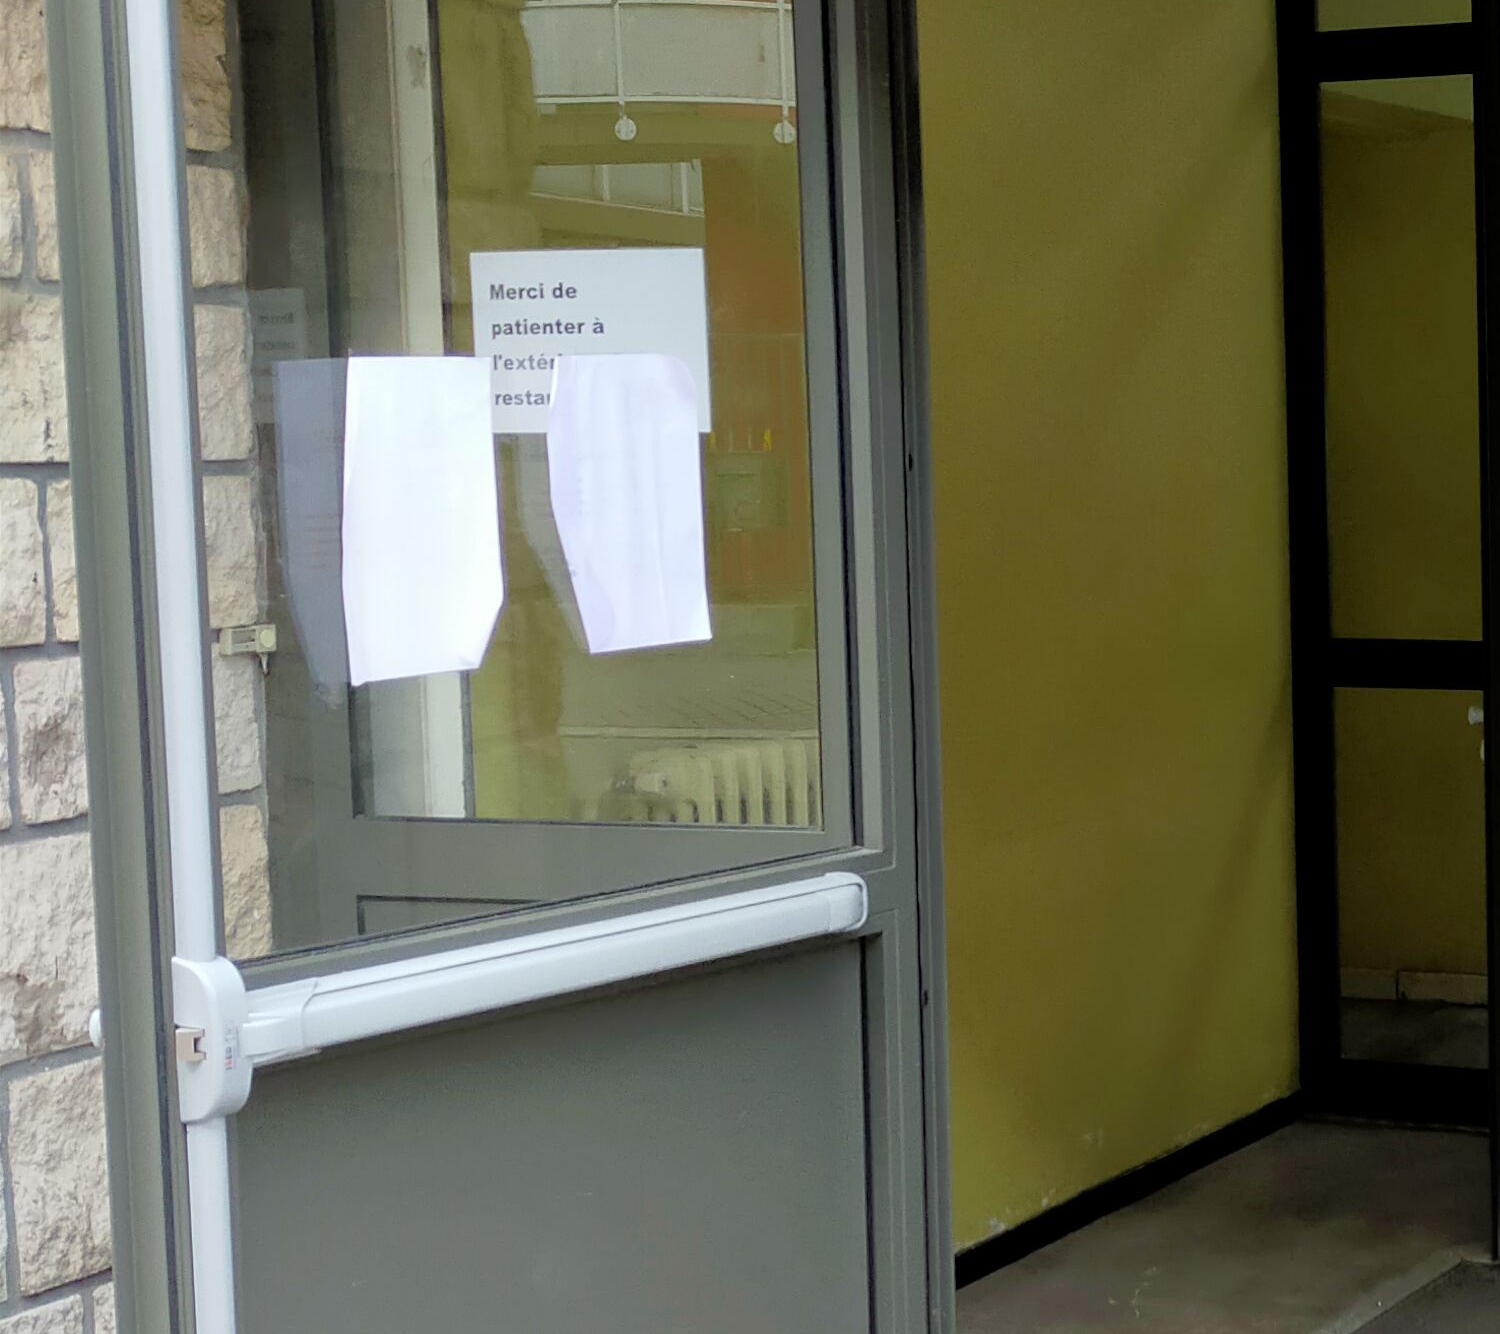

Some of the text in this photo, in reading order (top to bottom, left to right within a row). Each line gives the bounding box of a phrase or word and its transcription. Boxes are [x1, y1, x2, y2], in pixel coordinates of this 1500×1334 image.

[490, 282, 577, 300] Merci de
[492, 317, 604, 340] patienter à
[493, 353, 562, 371] l'extér
[495, 390, 551, 406] resta
